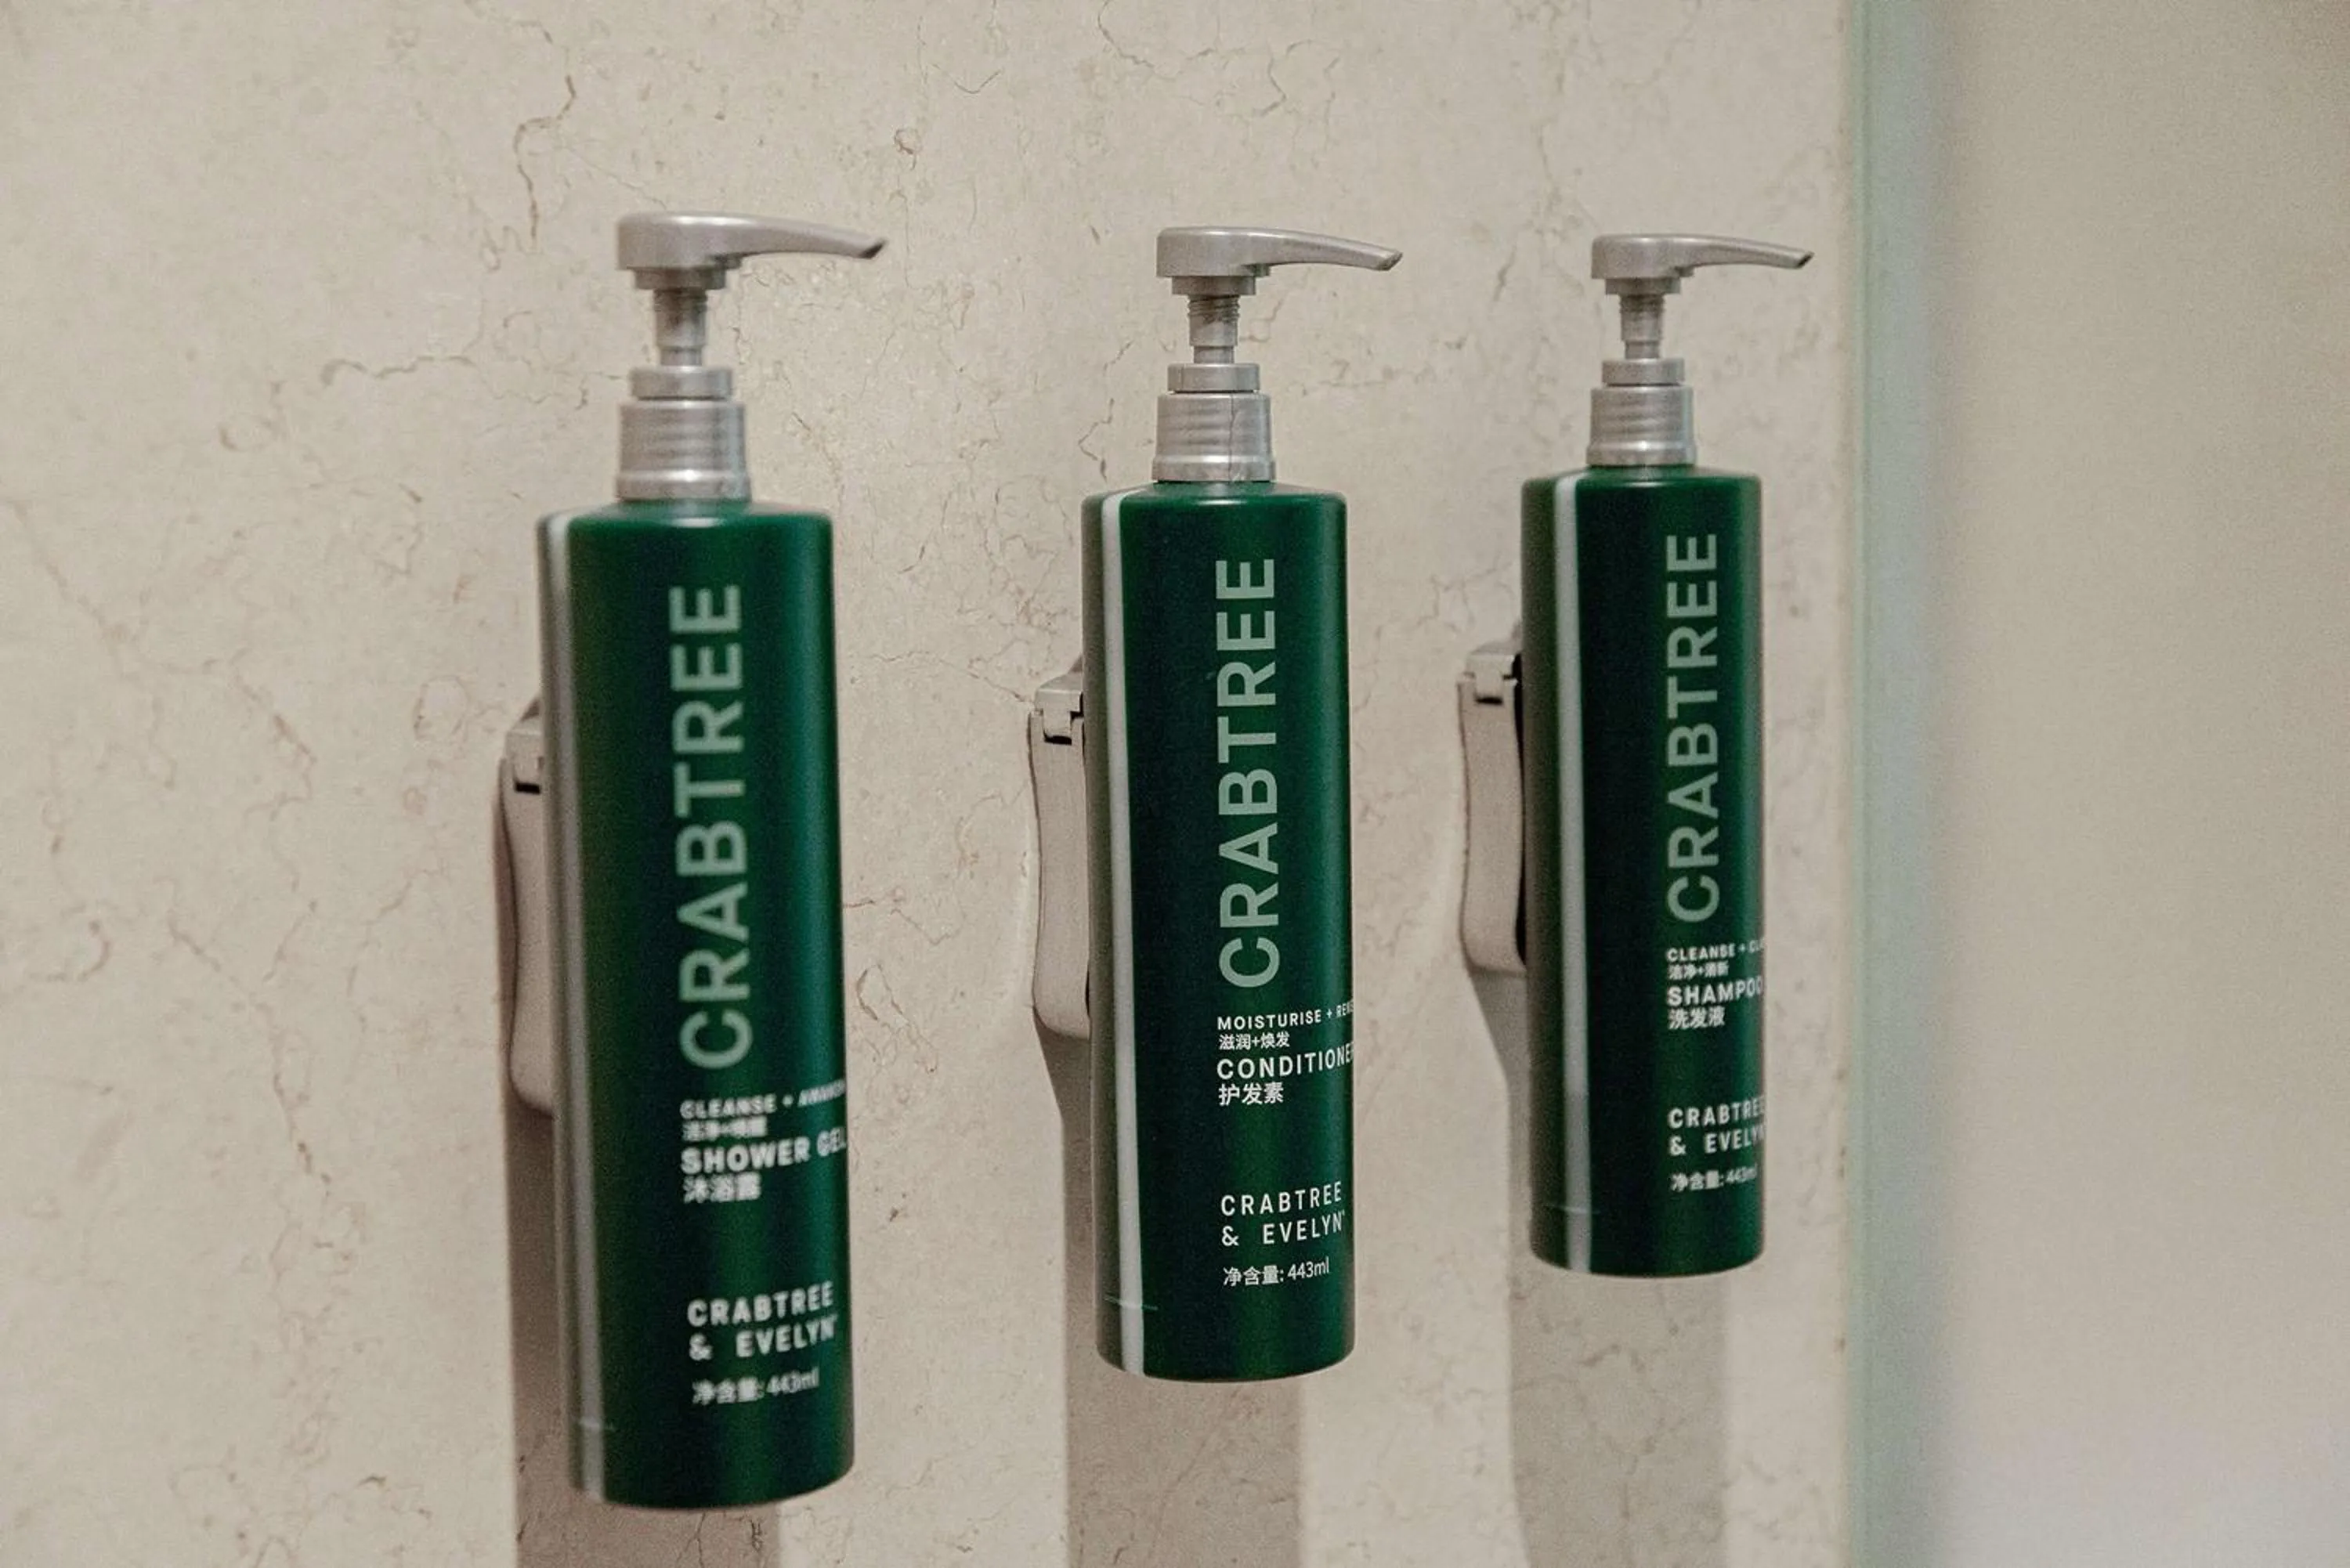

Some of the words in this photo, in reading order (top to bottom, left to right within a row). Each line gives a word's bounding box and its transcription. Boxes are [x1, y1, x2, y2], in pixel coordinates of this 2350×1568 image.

[1665, 533, 1720, 923] CRABTREE
[1216, 558, 1281, 988] CRABTREE
[668, 585, 753, 1069] CRABTREE
[1667, 943, 1736, 962] CLEANSE
[1217, 1009, 1321, 1030] MOISTURISE
[1326, 1008, 1332, 1018] +
[680, 1094, 776, 1119] CLEANSE
[1219, 1082, 1284, 1106] 护发素
[681, 1136, 810, 1174] SHOWER
[1669, 1136, 1686, 1156] &
[1221, 1181, 1342, 1216] CRABTREE
[1221, 1225, 1239, 1247] &
[1263, 1210, 1343, 1245] EVELYN
[687, 1281, 833, 1327] CRABTREE
[689, 1333, 713, 1360] &
